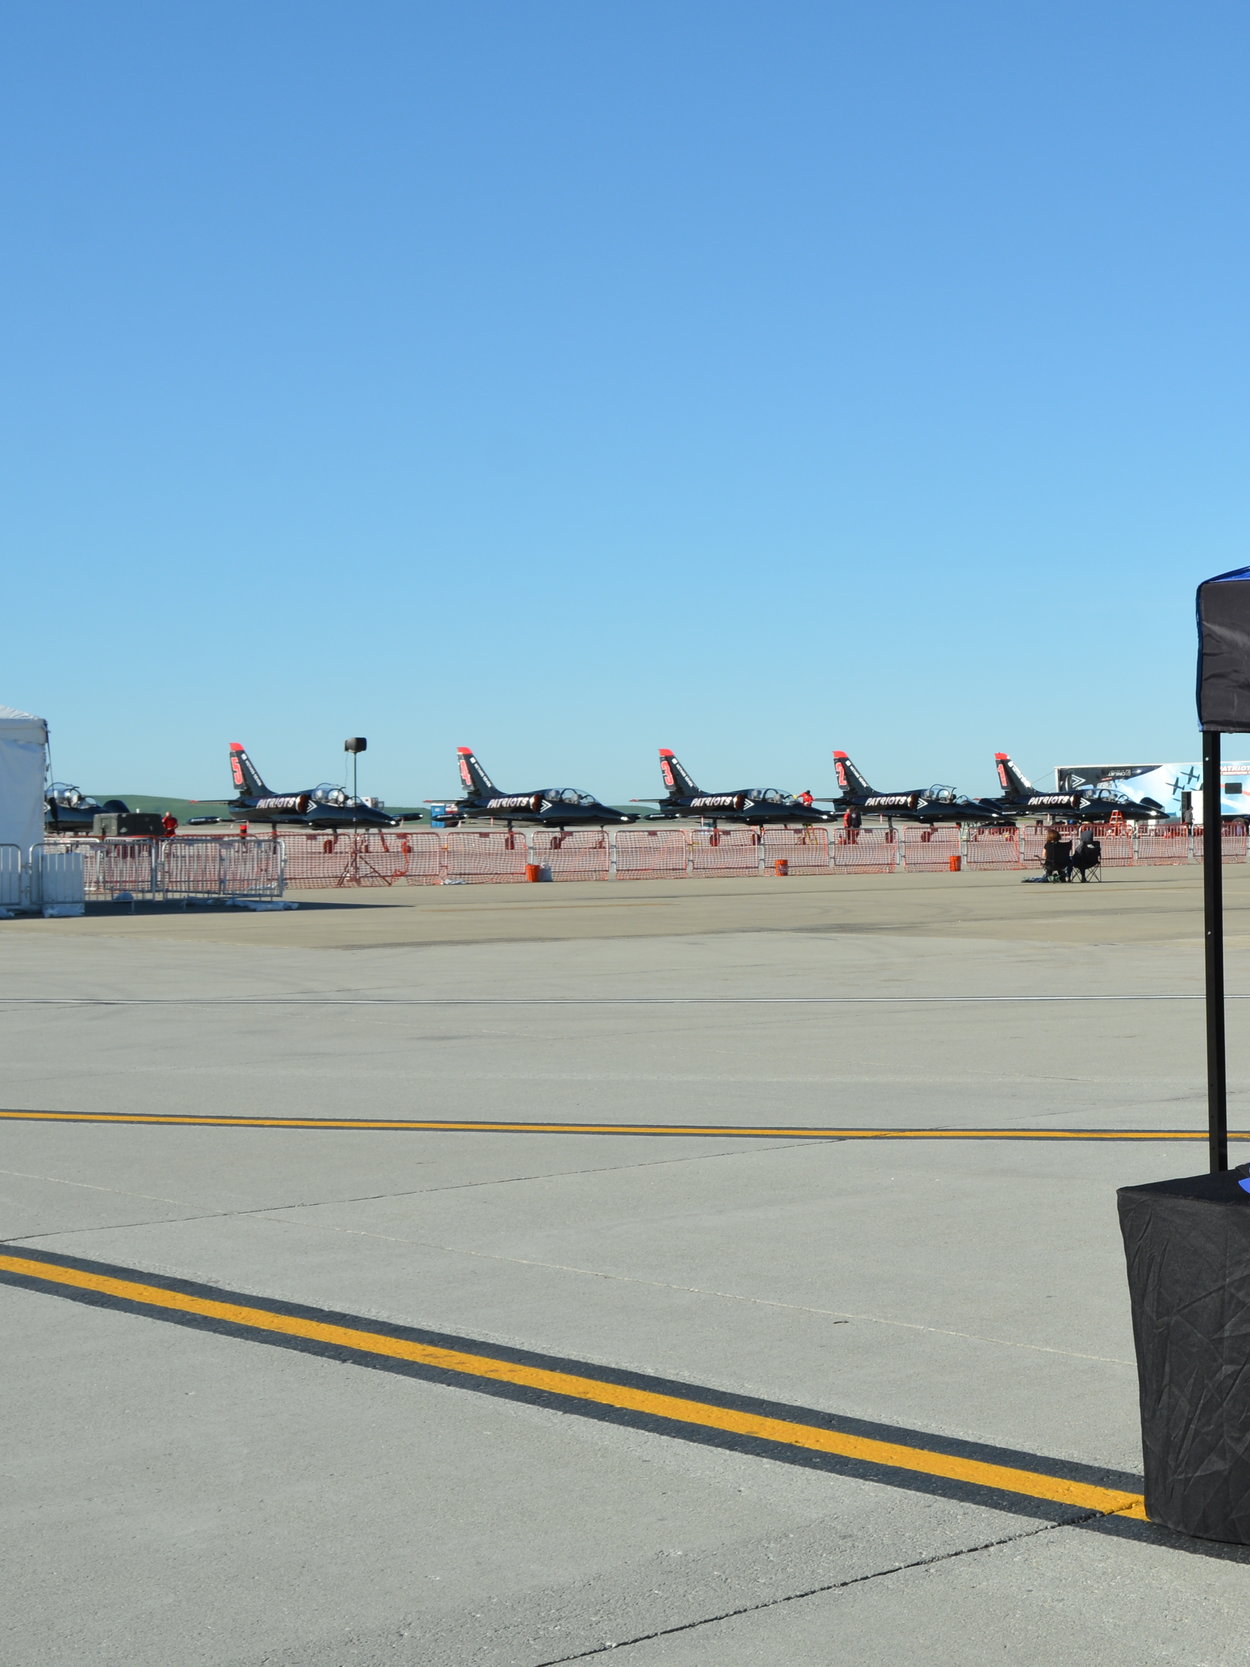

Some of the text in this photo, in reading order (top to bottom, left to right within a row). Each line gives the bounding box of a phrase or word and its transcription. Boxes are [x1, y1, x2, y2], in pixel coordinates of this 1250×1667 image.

[230, 756, 244, 785] 5
[459, 759, 473, 786] 4
[660, 760, 675, 786] 3
[835, 762, 849, 786] 2
[997, 763, 1009, 787] 1
[256, 797, 296, 809] PATRIOTS
[486, 796, 530, 808] PATRIOTS
[690, 796, 733, 808] PATRIOTS
[864, 796, 907, 807] PATRIOTS
[1027, 795, 1070, 806] PATRIOTS
